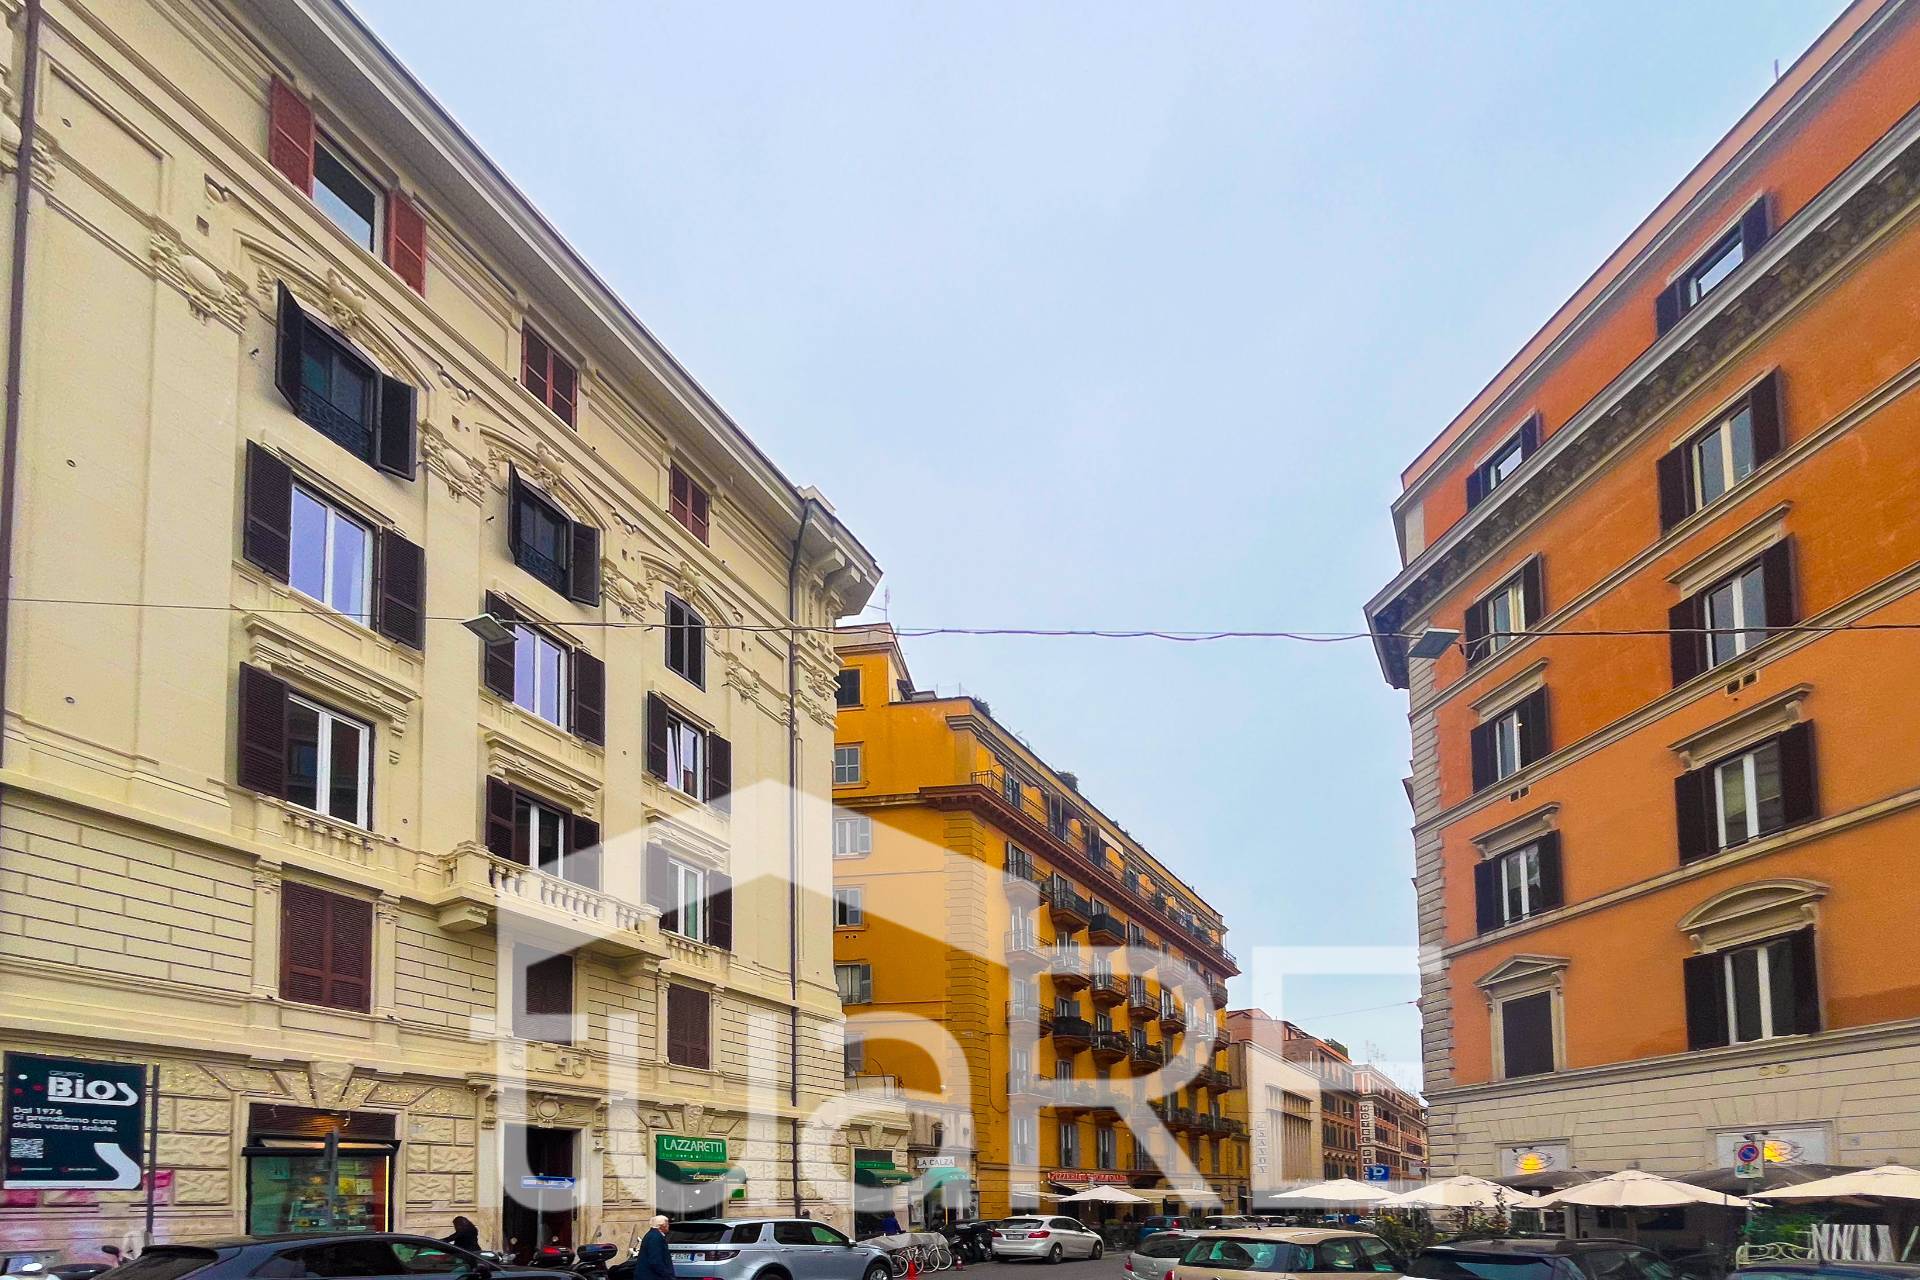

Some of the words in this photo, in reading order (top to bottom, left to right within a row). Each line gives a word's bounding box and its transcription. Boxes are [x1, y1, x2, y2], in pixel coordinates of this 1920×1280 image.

[13, 1106, 32, 1114] Dal
[12, 1121, 42, 1129] della
[663, 1138, 723, 1153] LAZZARETTI
[917, 1159, 927, 1167] LA
[929, 1158, 954, 1166] CALZA
[1373, 1167, 1385, 1176] P
